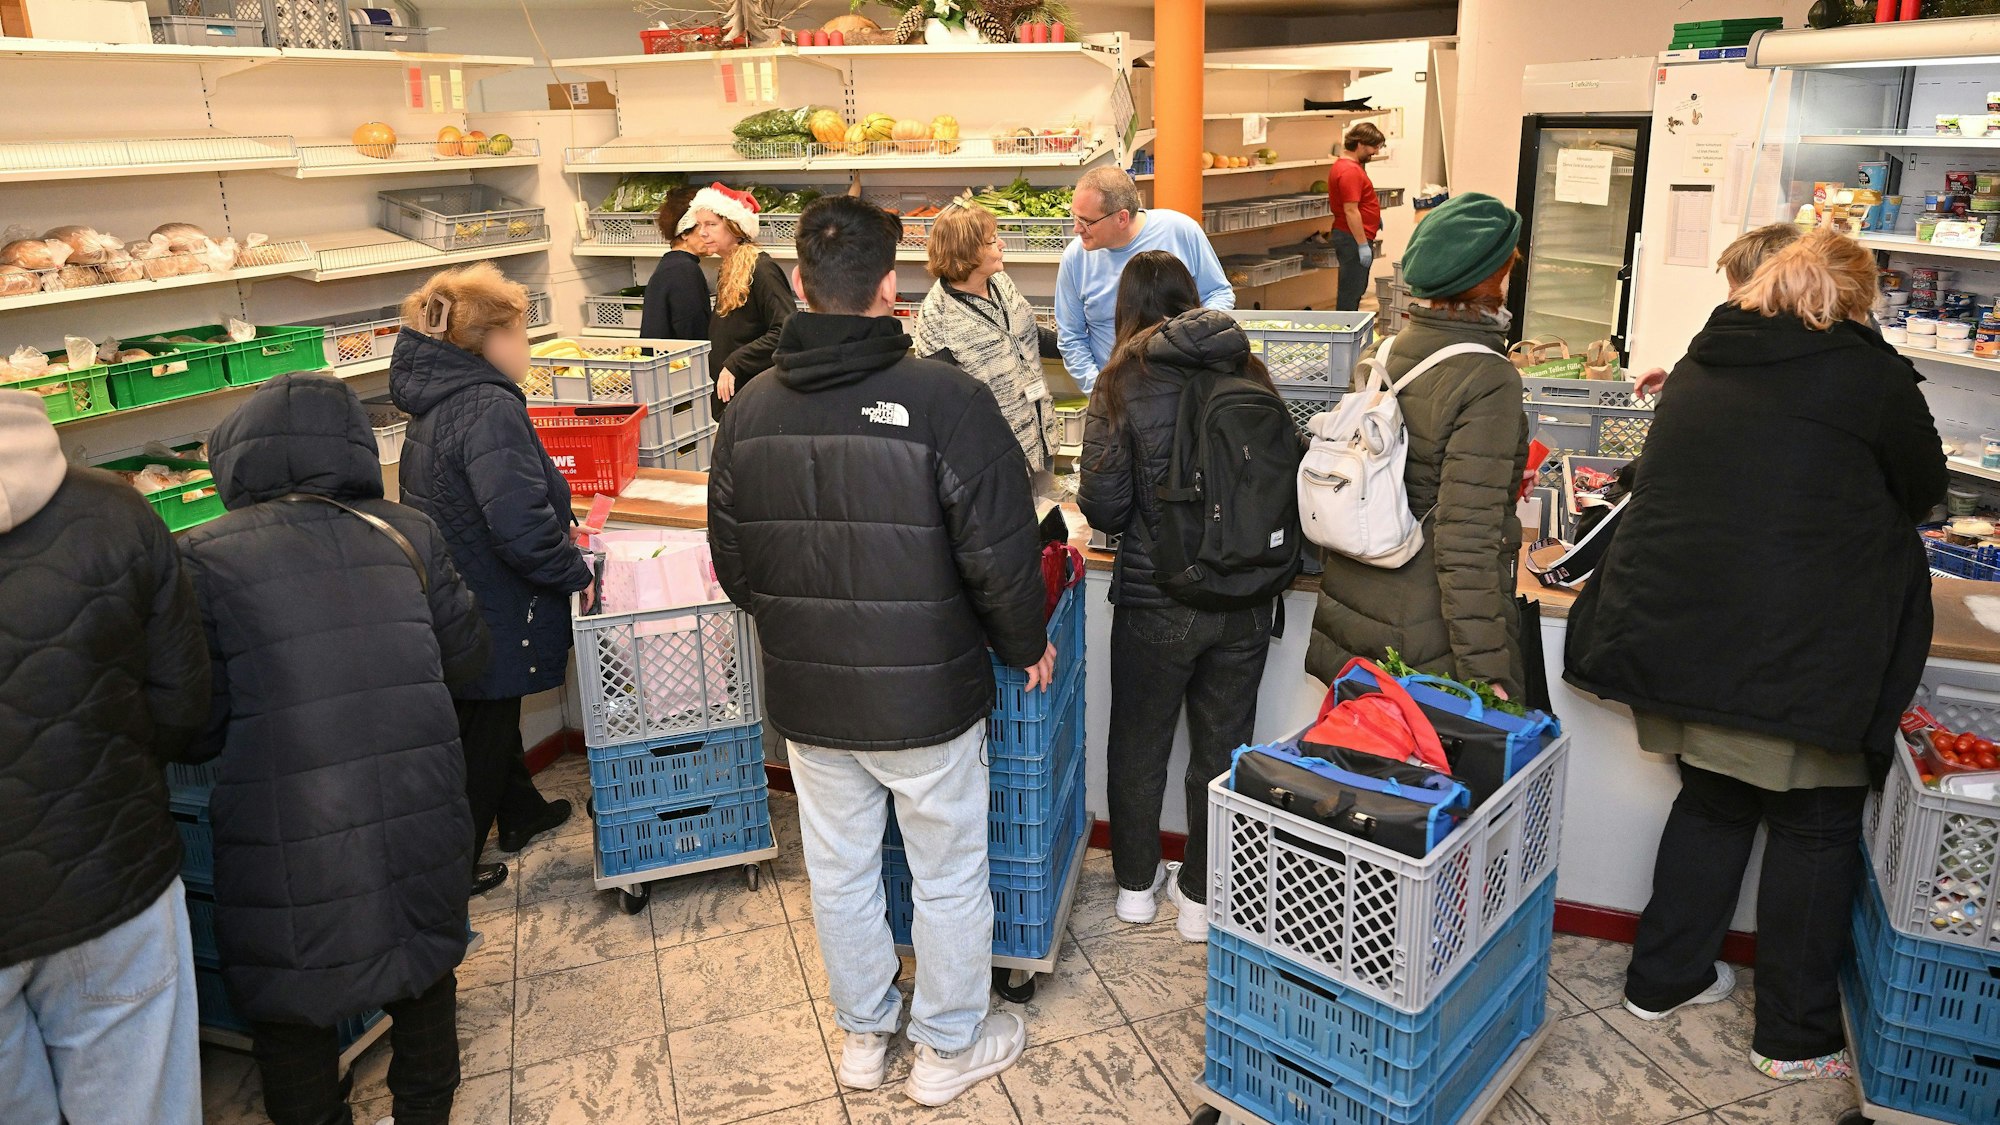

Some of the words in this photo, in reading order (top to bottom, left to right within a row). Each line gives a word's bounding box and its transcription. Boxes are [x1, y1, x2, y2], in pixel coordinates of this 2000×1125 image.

[1548, 365, 1566, 374] Teller
[876, 401, 895, 411] THE
[861, 407, 894, 418] NORTH
[869, 415, 894, 425] FACE
[550, 455, 576, 467] WE
[558, 467, 577, 475] we.de
